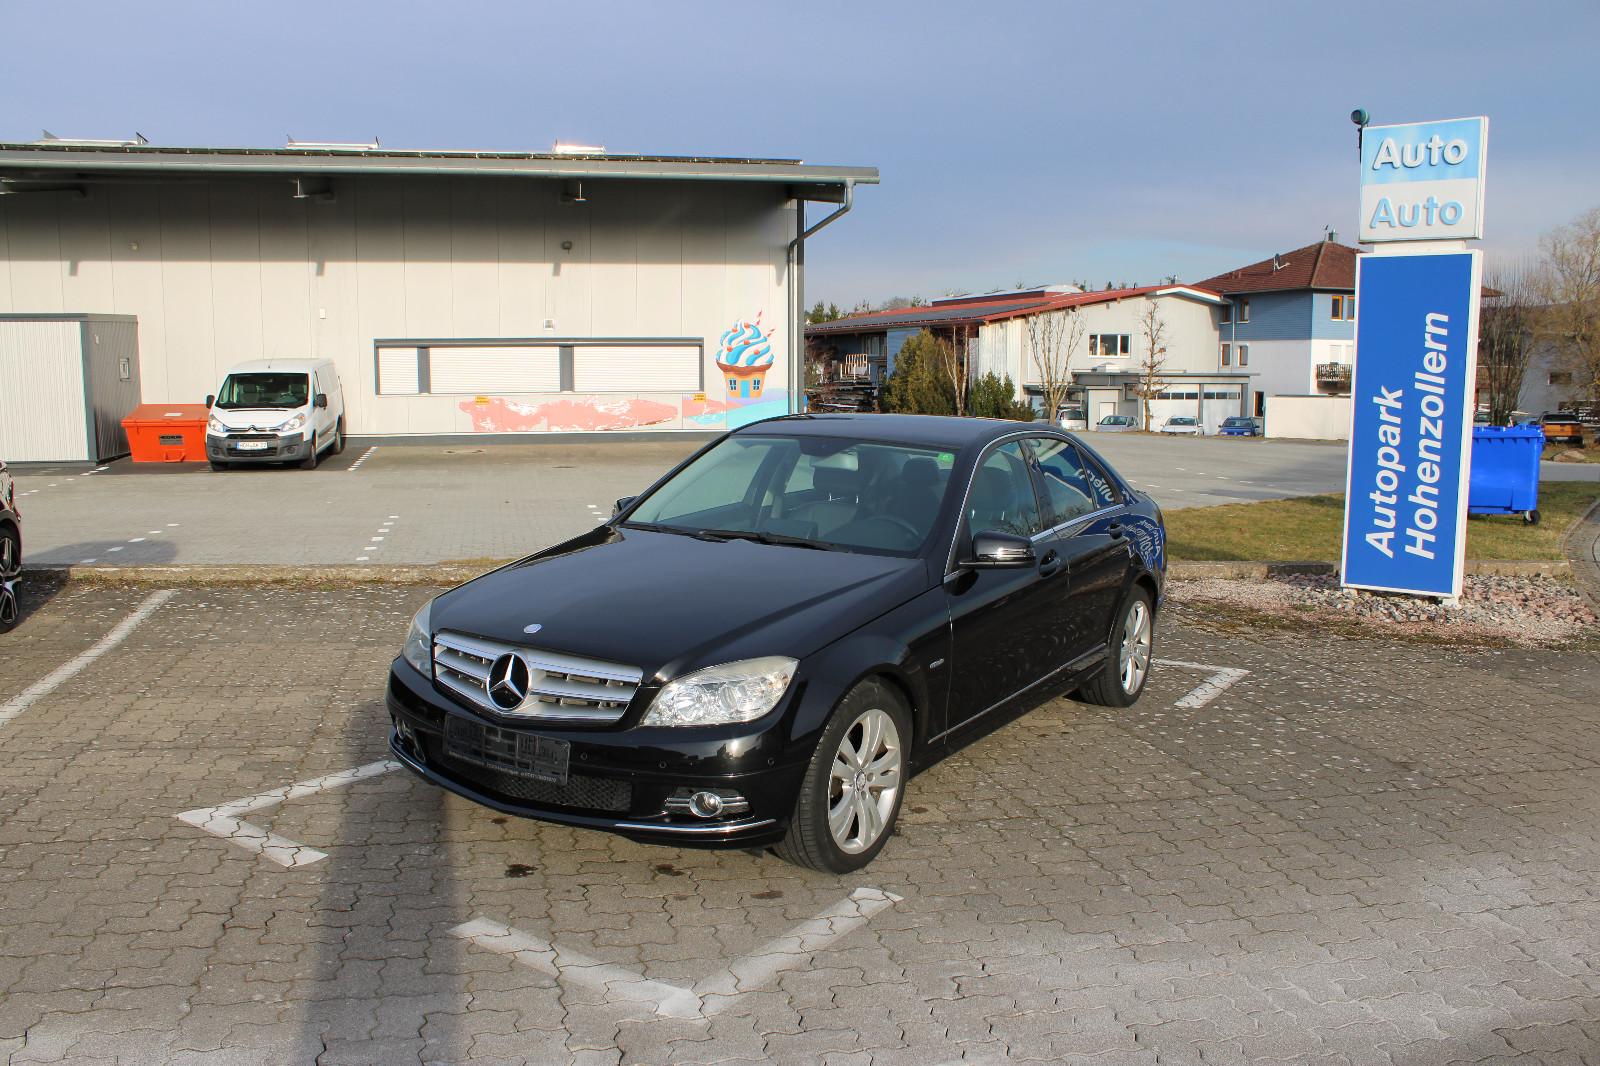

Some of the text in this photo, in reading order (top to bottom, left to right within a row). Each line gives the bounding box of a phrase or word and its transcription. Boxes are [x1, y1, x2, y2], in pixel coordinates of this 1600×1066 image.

[1372, 134, 1468, 170] Auto
[1369, 195, 1465, 229] Auto
[1365, 385, 1406, 559] Autopark
[1404, 311, 1449, 560] Hohenzollern
